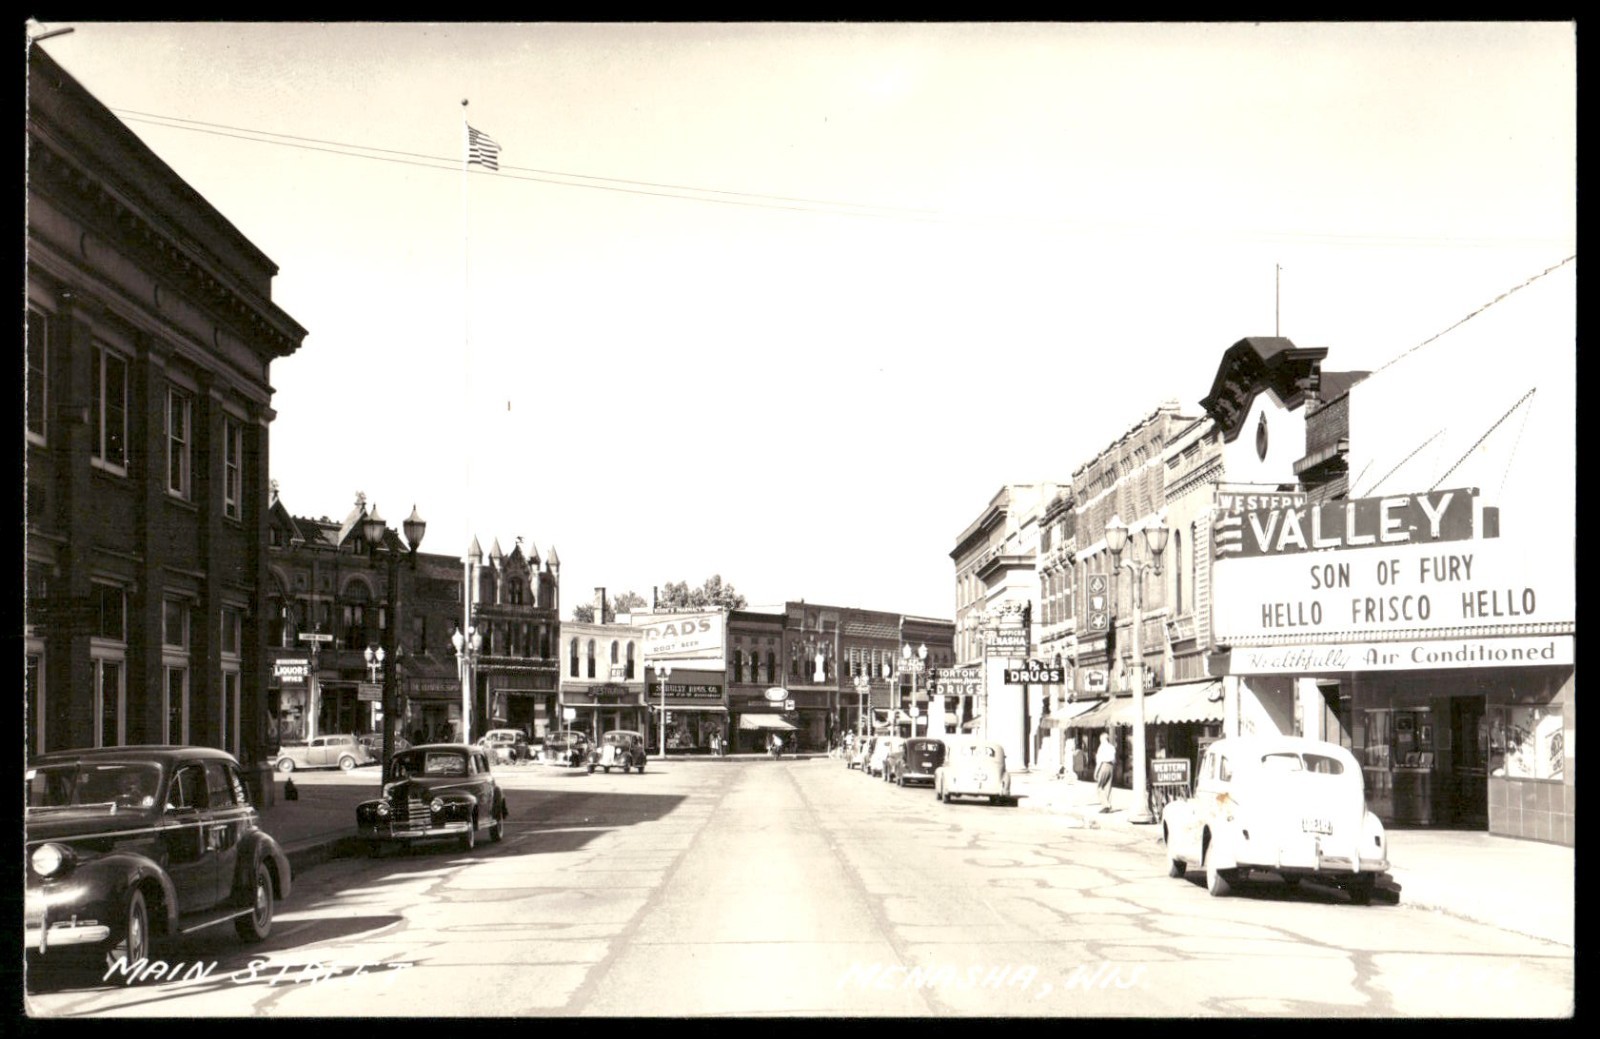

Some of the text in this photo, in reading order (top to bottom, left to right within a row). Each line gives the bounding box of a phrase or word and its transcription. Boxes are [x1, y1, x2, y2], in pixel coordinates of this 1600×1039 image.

[1219, 494, 1303, 510] WESTERN
[1248, 493, 1454, 553] VALLEY
[1311, 554, 1474, 590] SON OF FURY
[1262, 588, 1537, 628] HELLO FRISCO HELLO
[653, 644, 675, 653] ROOT
[1248, 642, 1555, 670] Healthfully Air Conditioned
[274, 665, 309, 676] LIQUORS
[1011, 671, 1060, 682] DRUGS
[656, 685, 686, 693] SHULTZ
[937, 684, 983, 694] DRUGS
[1153, 763, 1186, 772] WESTERN
[1157, 772, 1182, 782] UNION
